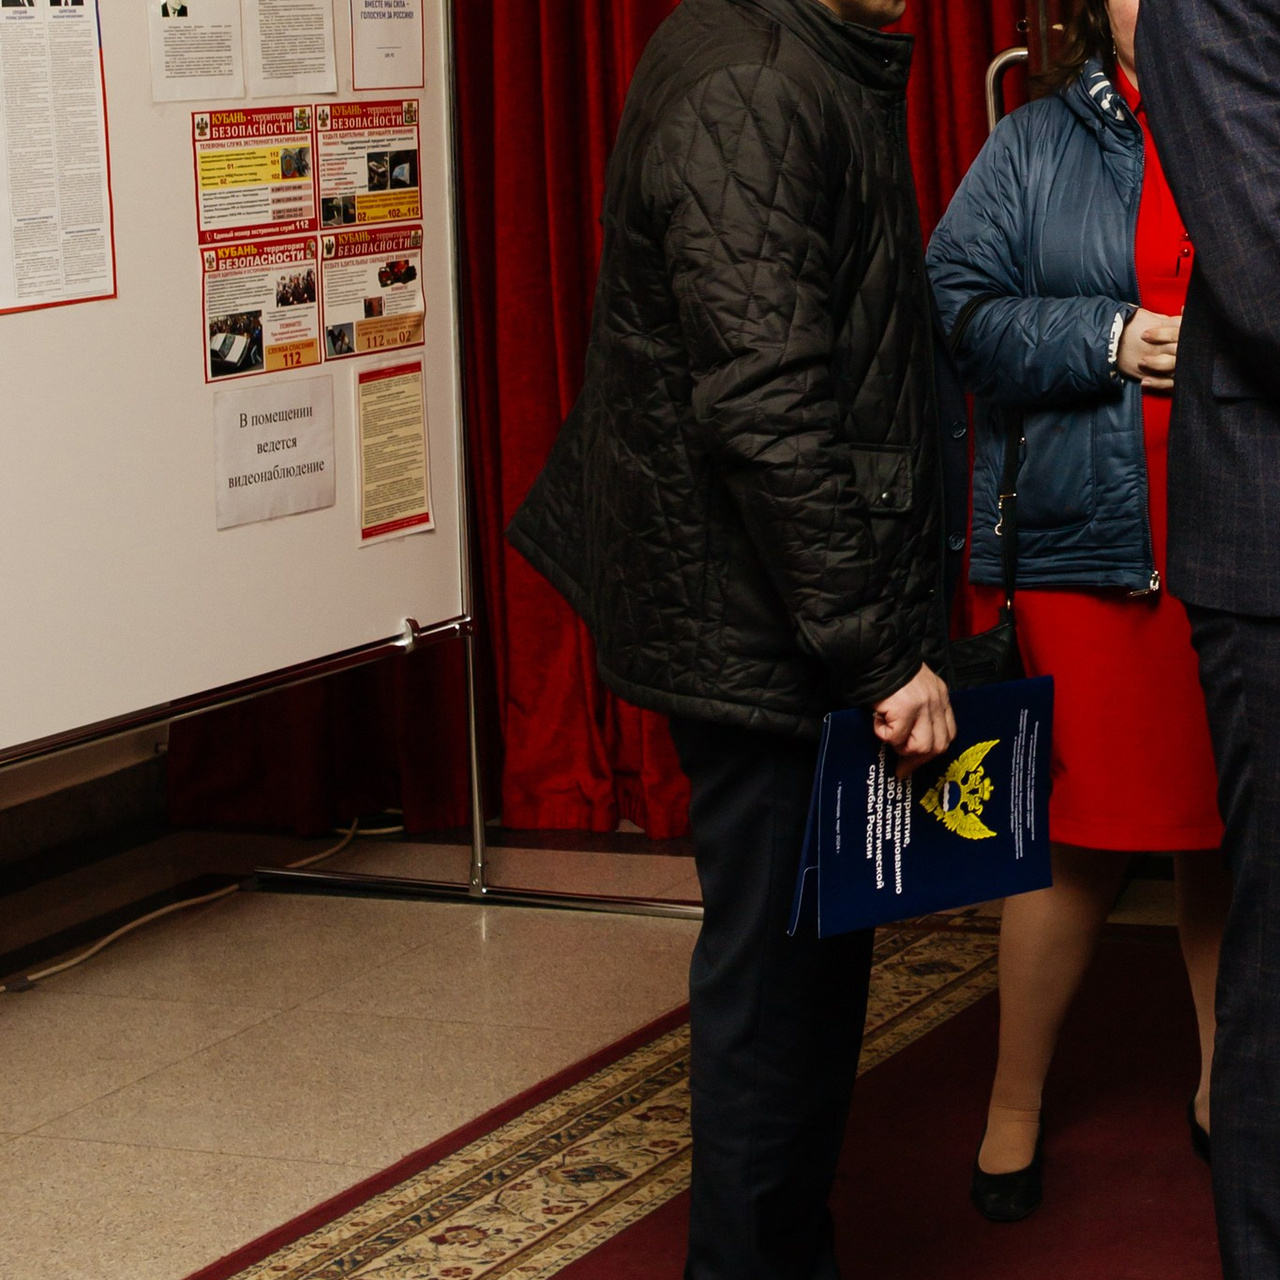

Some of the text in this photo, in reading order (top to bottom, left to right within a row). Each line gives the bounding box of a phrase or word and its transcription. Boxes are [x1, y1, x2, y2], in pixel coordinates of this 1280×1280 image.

[364, 0, 383, 9] ВМЕСТЕ
[384, 0, 392, 9] МЫ
[360, 11, 387, 20] ГОЛОСУЕМ
[211, 111, 293, 125] КУБАНЬ территория
[332, 105, 402, 118] КУБАНЬ территория
[212, 121, 294, 139] БЕЗОПАСНОСТИ
[332, 115, 402, 129] БЕЗОПАСНОСТИ
[357, 212, 367, 222] 02
[388, 208, 401, 218] 102
[407, 206, 419, 216] 112
[296, 220, 309, 230] 112
[338, 231, 370, 245] КУБАНЬ
[217, 242, 305, 259] КУБАНЬ территория
[338, 238, 411, 257] БЕЗОПАСНОСТИ
[218, 250, 304, 270] БЕЗОПАСНОСТИ
[367, 335, 384, 349] 112
[399, 330, 411, 343] 02
[283, 351, 302, 367] 112
[239, 406, 313, 428] В помещении
[257, 437, 297, 454] ведется
[228, 460, 325, 489] видеонаблюдение
[866, 764, 877, 859] службы России
[885, 776, 896, 840] 190-летия
[893, 802, 903, 895] празднованию
